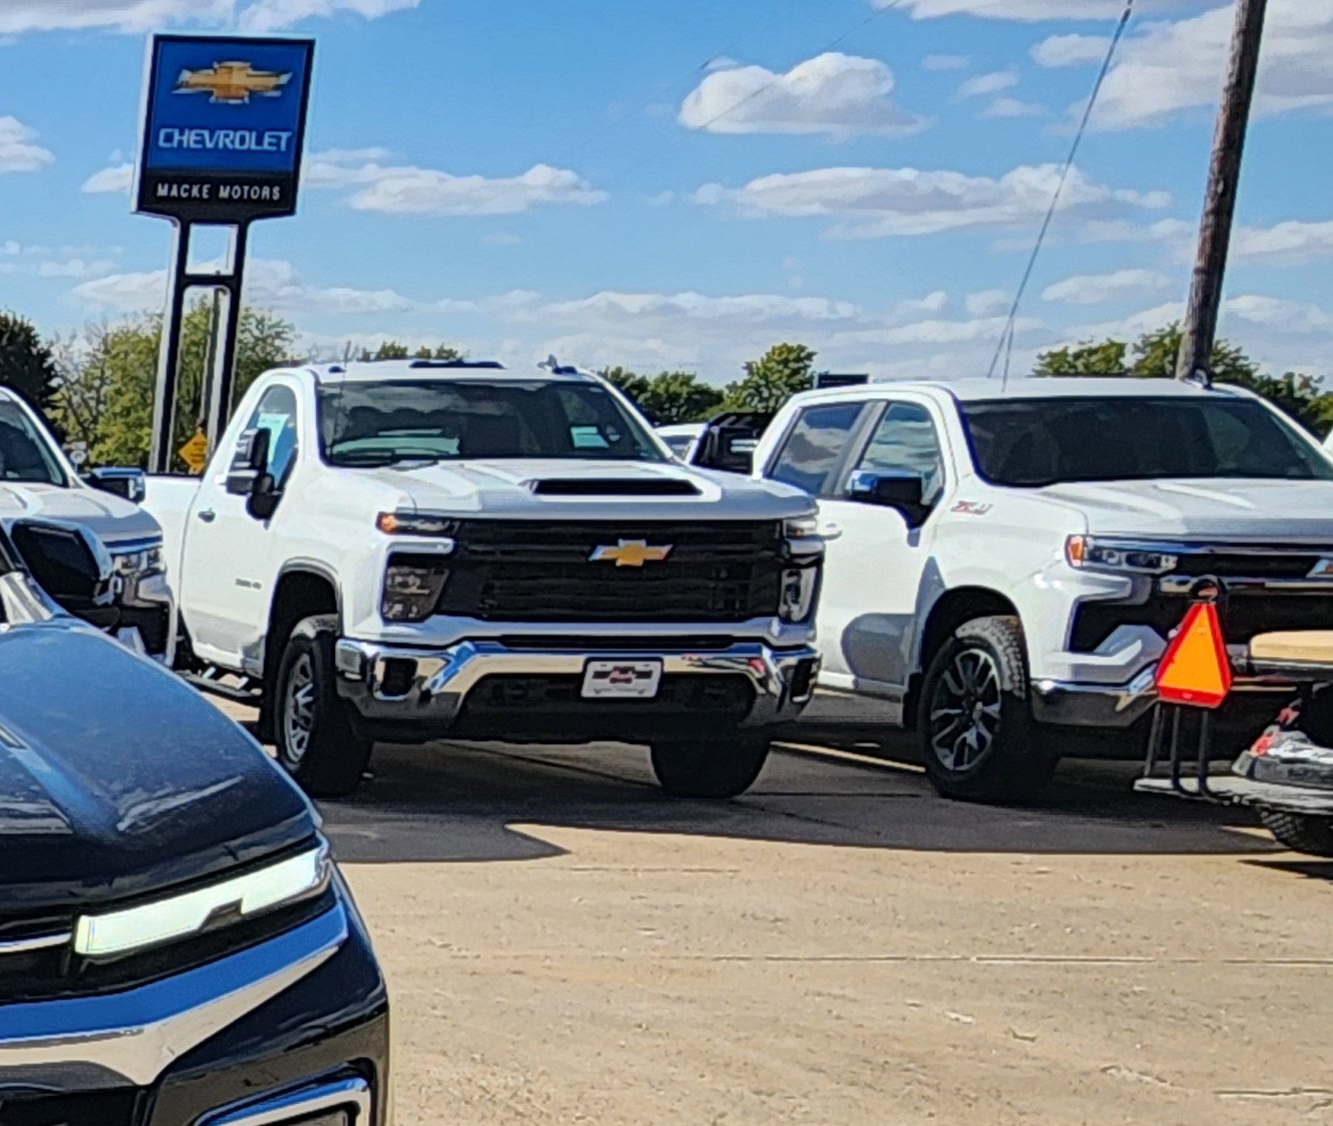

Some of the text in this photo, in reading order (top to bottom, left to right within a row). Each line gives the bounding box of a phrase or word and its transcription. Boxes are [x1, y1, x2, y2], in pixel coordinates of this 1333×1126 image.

[158, 128, 293, 152] CHEVROLET
[156, 183, 281, 201] MACKE MOTORS
